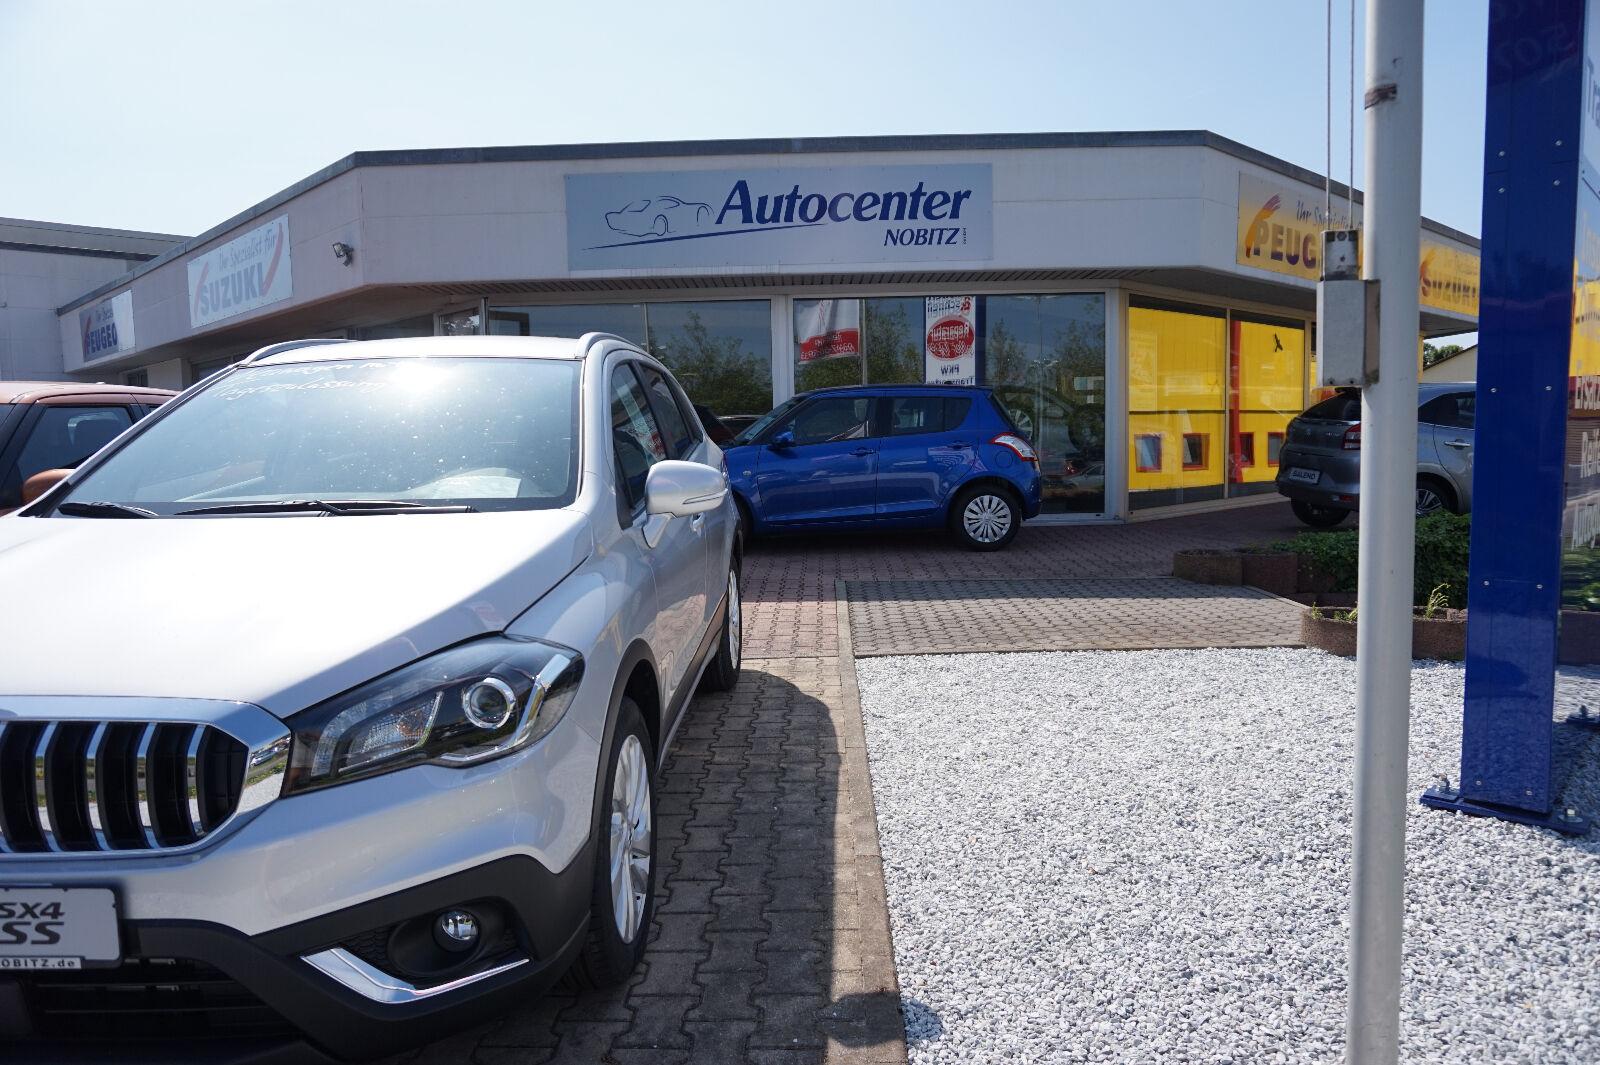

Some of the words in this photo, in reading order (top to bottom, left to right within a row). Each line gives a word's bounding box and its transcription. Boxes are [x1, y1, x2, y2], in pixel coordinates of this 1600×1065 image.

[715, 179, 973, 225] Autocenter
[883, 227, 961, 247] NOBITZ
[1253, 221, 1318, 270] PEUG
[199, 263, 264, 316] SUZUKI
[84, 321, 119, 355] PEUGEO
[0, 902, 65, 920] SX4
